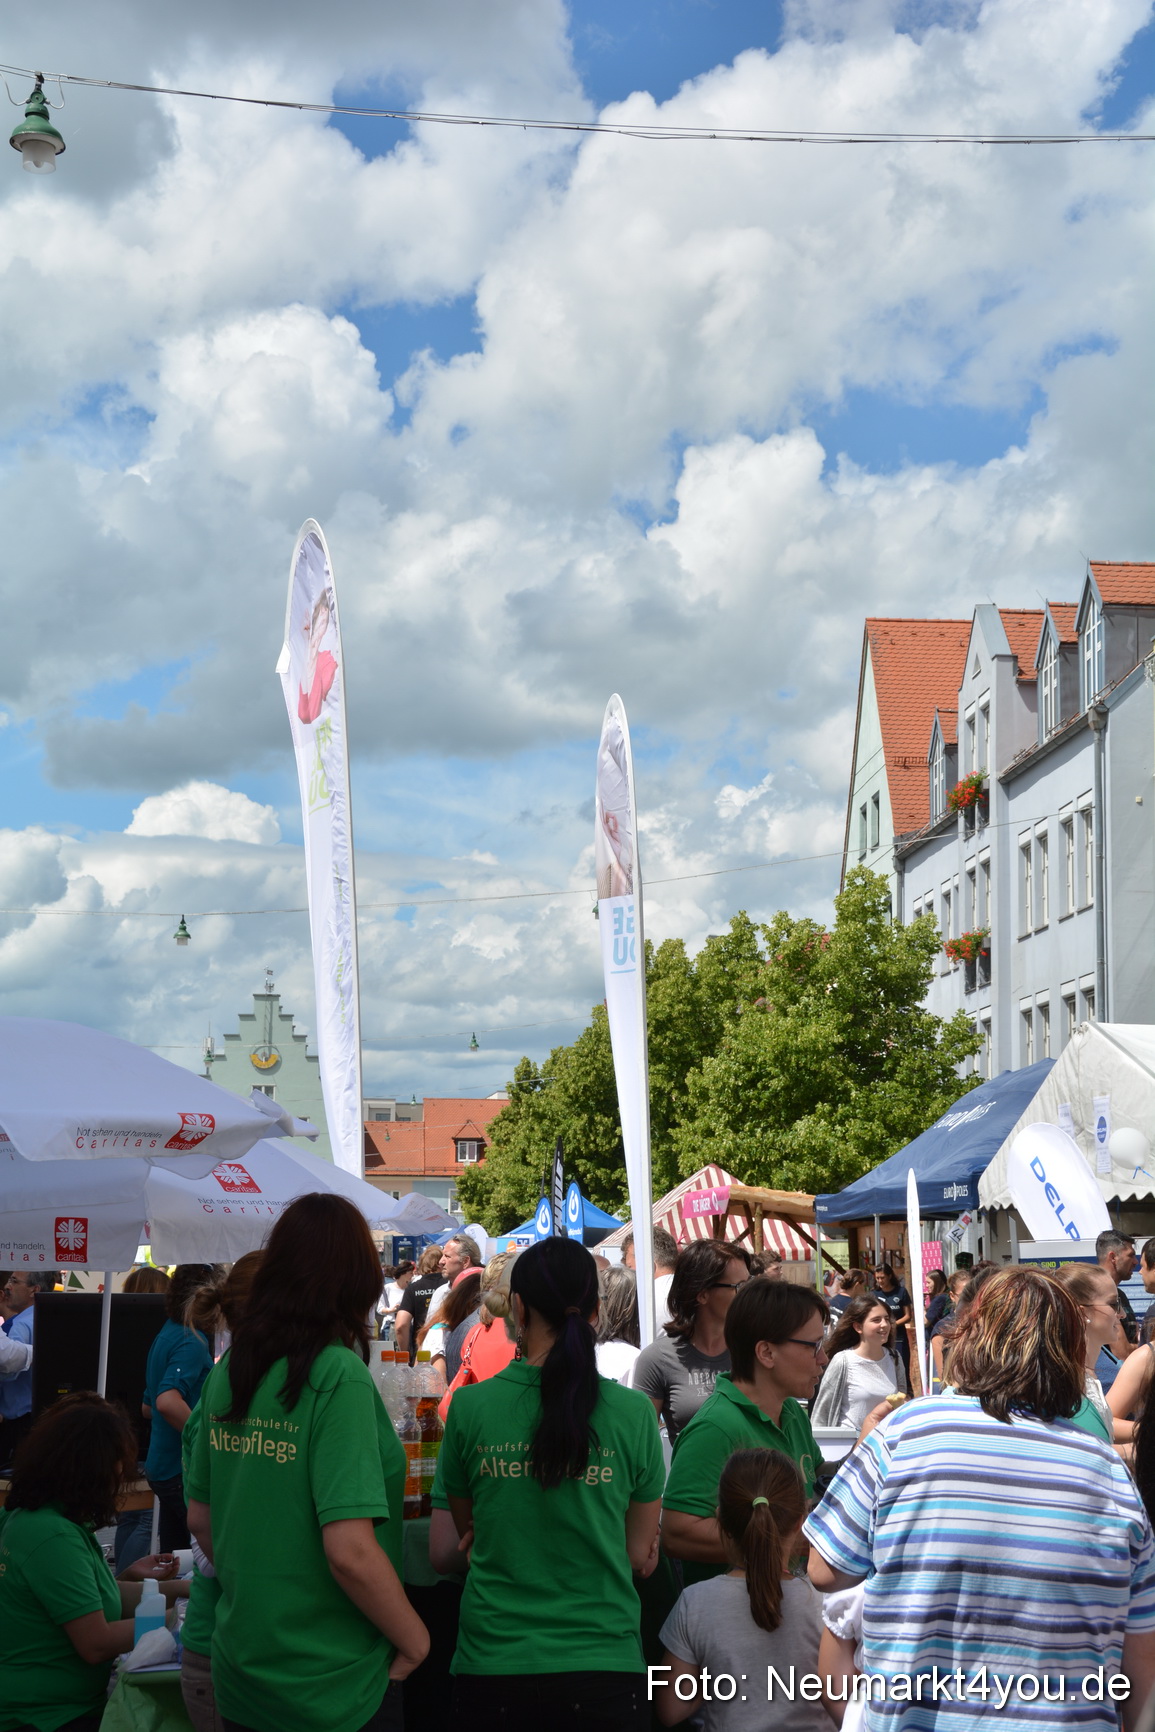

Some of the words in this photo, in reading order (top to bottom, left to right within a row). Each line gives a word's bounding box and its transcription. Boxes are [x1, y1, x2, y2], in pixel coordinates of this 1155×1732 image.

[77, 1127, 90, 1136] Not
[91, 1128, 113, 1137] sehen
[76, 1136, 157, 1149] Caritas
[225, 1185, 259, 1193] caritas
[0, 1241, 11, 1250] nd
[57, 1252, 85, 1263] caritas
[283, 1421, 300, 1433] für
